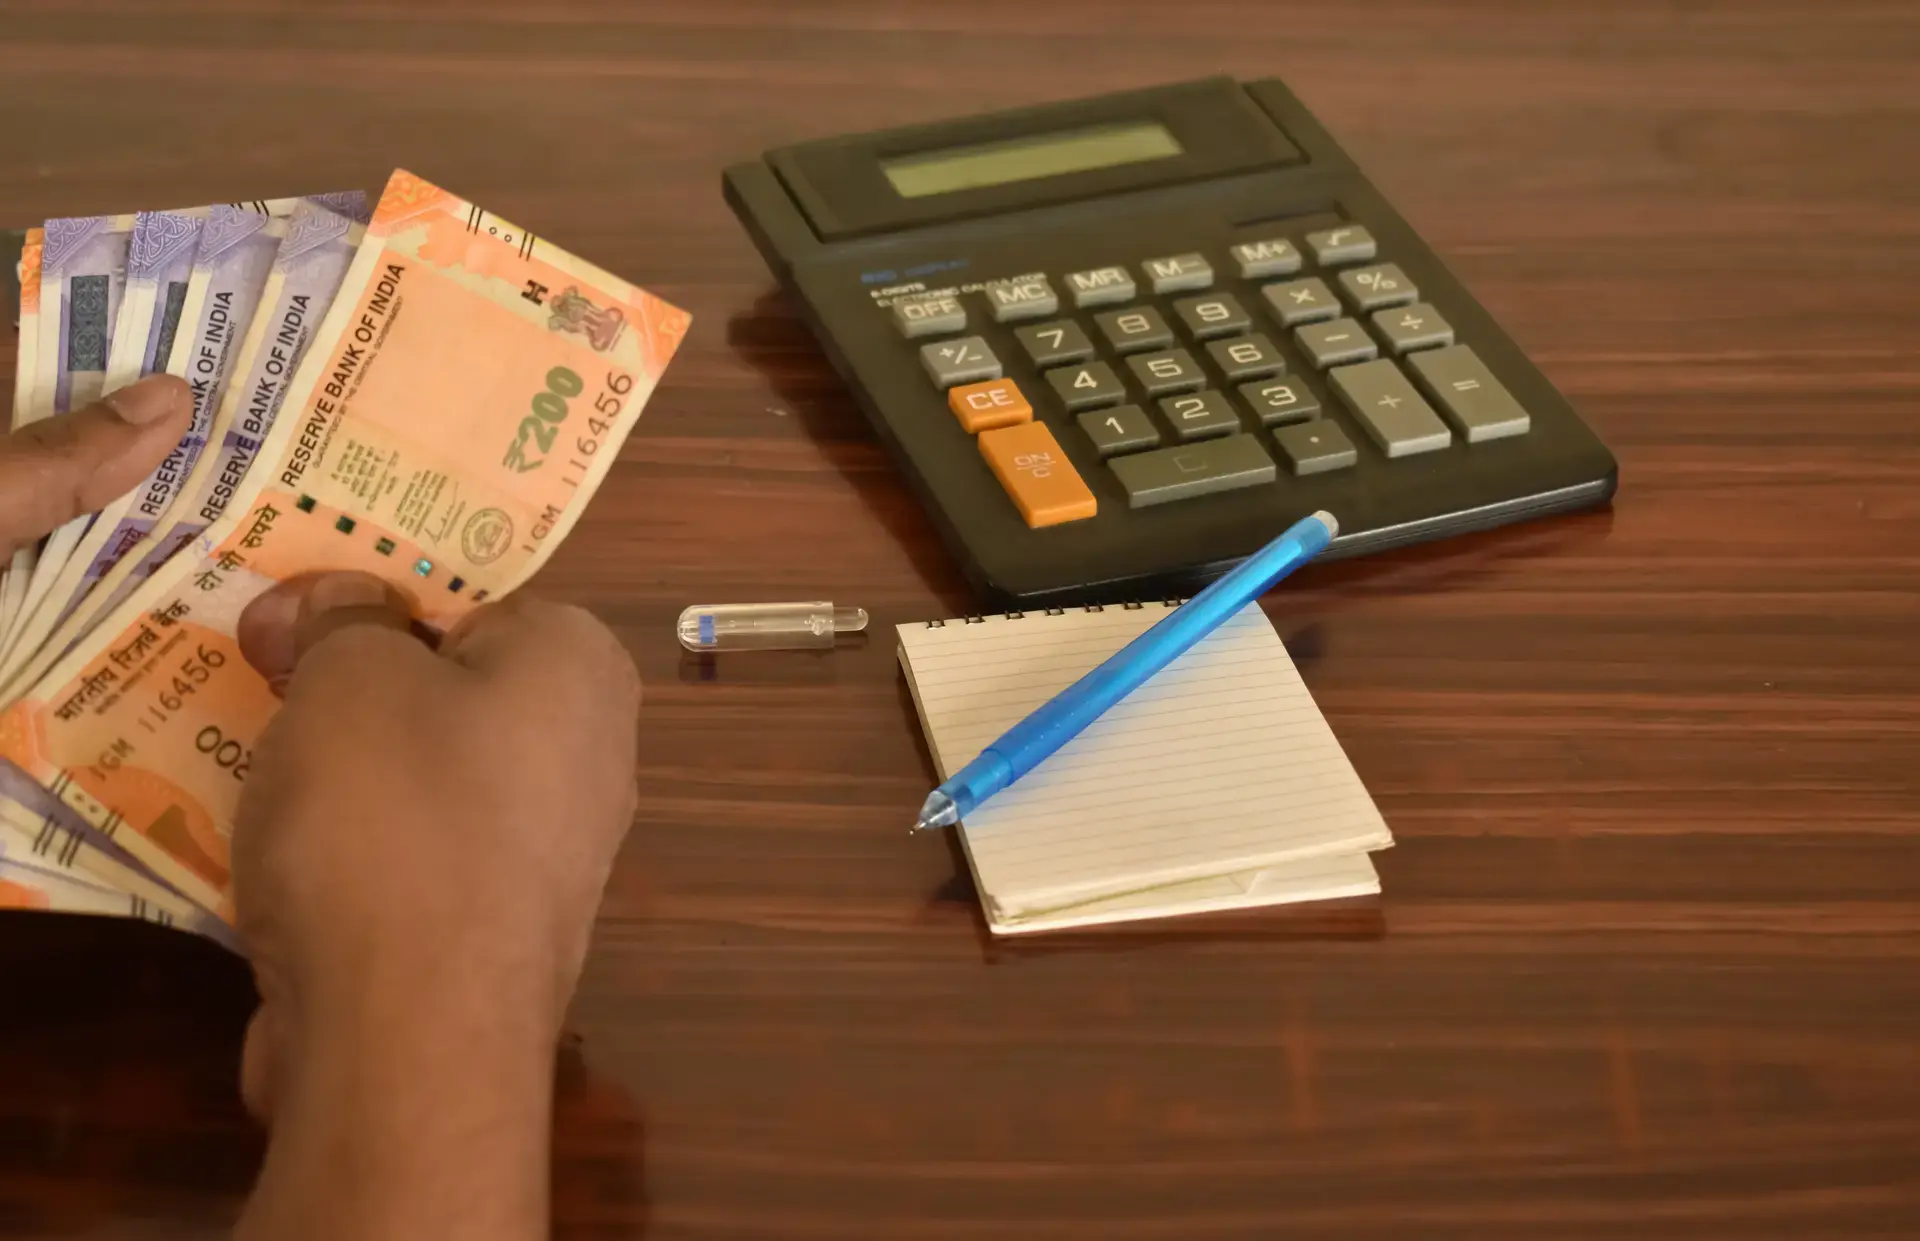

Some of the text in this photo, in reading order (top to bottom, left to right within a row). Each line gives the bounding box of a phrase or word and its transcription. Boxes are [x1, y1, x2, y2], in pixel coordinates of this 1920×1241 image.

[1240, 243, 1288, 261] M+
[1072, 268, 1126, 290] MR
[1356, 272, 1398, 292] %
[995, 283, 1047, 304] MC
[204, 291, 234, 344] INDIA
[903, 298, 958, 320] OFF
[1195, 302, 1230, 322] 9
[1117, 314, 1151, 334] 8
[1036, 329, 1066, 349] 7
[196, 346, 217, 374] OF
[1228, 343, 1262, 364] 6
[203, 380, 221, 417] CENTRAL
[215, 321, 237, 378] GOVERNMENT
[281, 398, 335, 488] RESERVE
[324, 343, 366, 398] BANK
[355, 314, 377, 343] OF
[368, 263, 406, 316] INDIA
[1147, 358, 1183, 378] 5
[1073, 371, 1097, 390] 4
[965, 388, 1014, 411] CE
[1261, 385, 1297, 406] 3
[200, 295, 311, 522] RESERVE BANK OF INDIA
[1174, 398, 1210, 420] 2
[561, 370, 633, 488] 116456
[1105, 416, 1125, 435] 1
[140, 436, 190, 516] RESERVE
[138, 643, 226, 734] 116456
